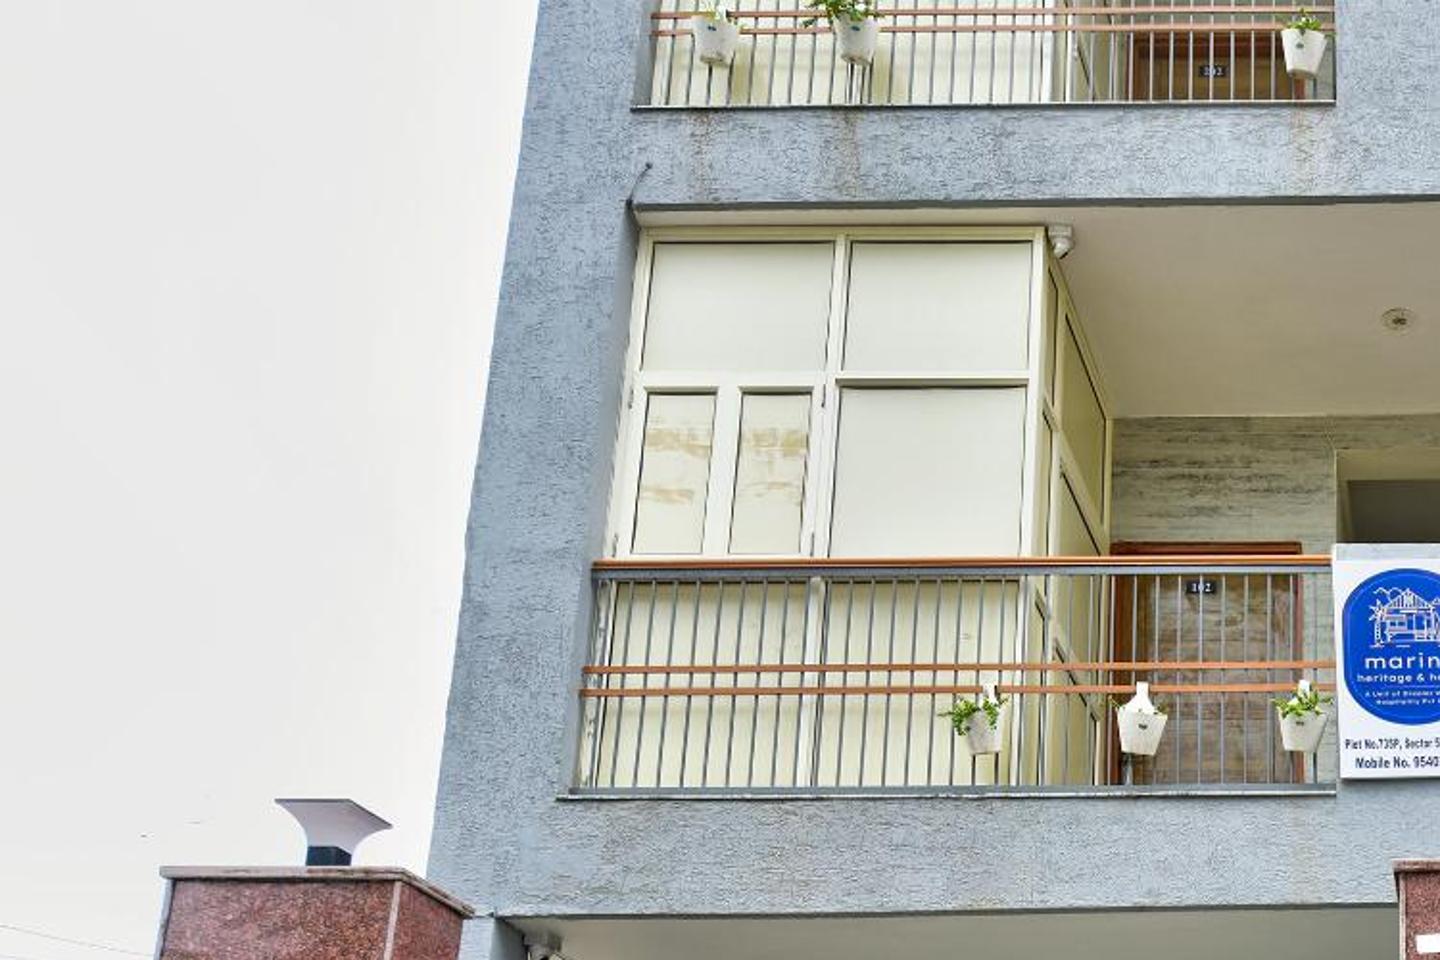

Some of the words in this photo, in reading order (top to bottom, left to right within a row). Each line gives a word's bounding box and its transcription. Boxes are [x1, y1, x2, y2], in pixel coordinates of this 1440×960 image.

[1356, 672, 1413, 684] heritage
[1416, 673, 1425, 682] &
[1405, 737, 1433, 749] Sector
[1355, 757, 1390, 769] Mobile
